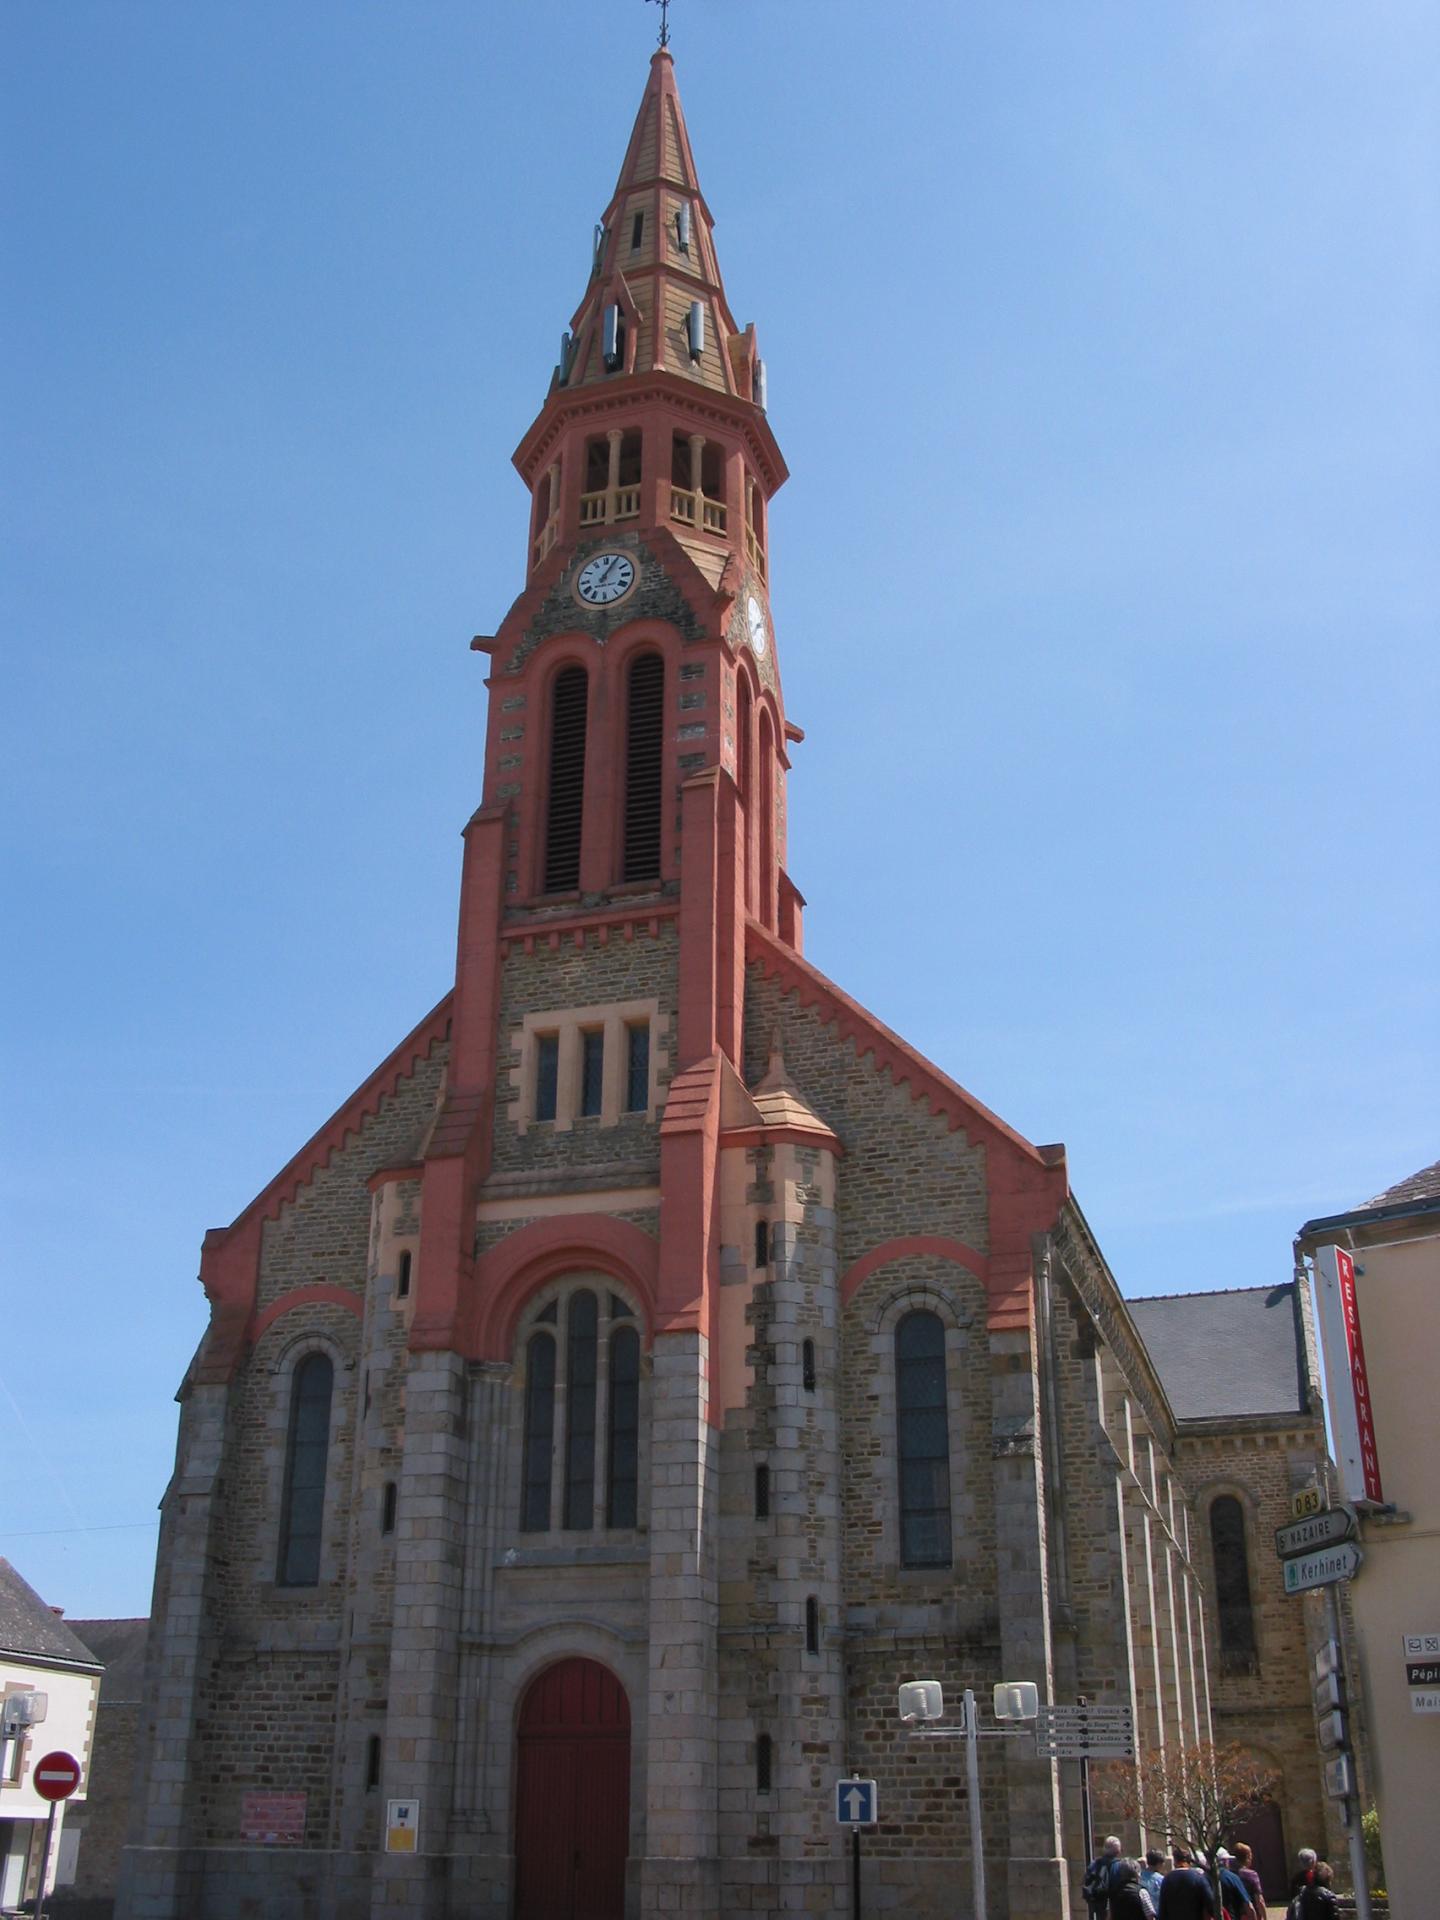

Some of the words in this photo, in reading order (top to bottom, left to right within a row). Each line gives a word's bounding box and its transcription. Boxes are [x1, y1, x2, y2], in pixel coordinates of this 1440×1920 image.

[1341, 1258, 1376, 1496] RESTAURANT
[1304, 1492, 1318, 1510] 83
[1290, 1520, 1330, 1546] NAZAIRE
[1301, 1555, 1347, 1580] Kerhinet
[1411, 1667, 1440, 1682] Pépi
